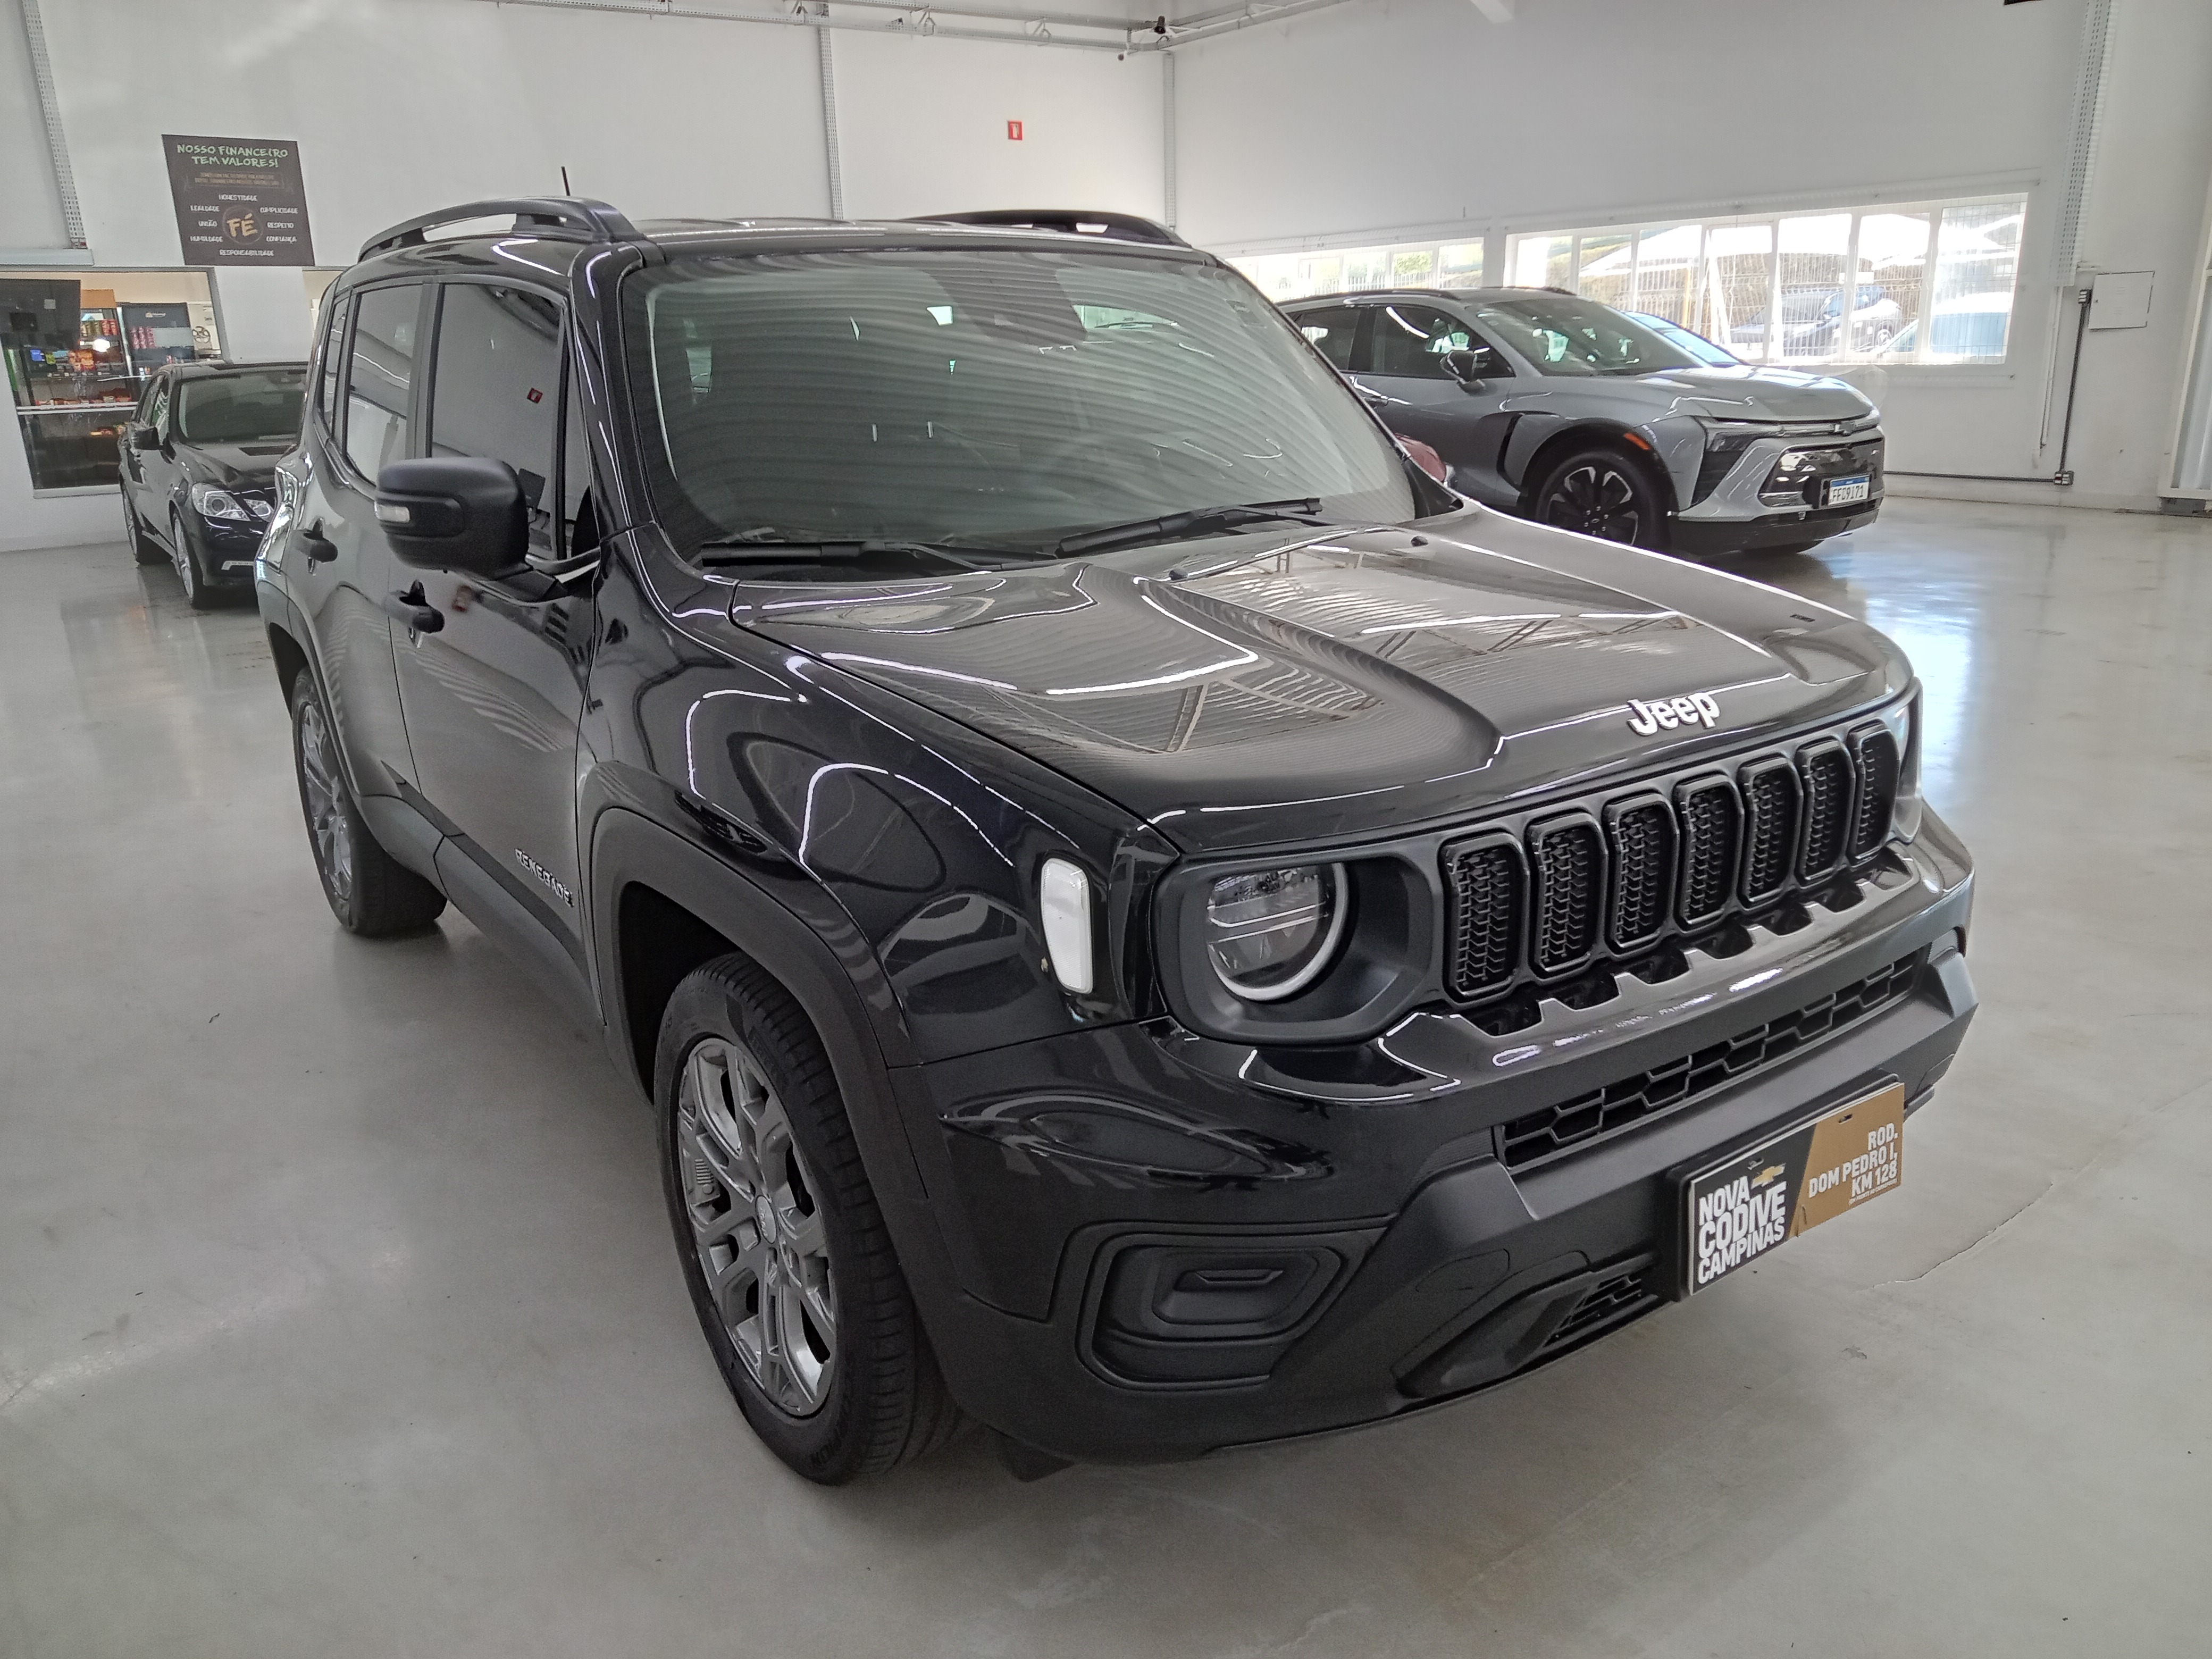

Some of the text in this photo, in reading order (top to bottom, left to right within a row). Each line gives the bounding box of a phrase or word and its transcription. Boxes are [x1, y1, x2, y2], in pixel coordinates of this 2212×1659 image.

[177, 144, 289, 158] NOSSO FINANCEIRO
[191, 156, 279, 167] TEM VALORES!
[227, 213, 258, 237] FÉ
[1626, 692, 1721, 736] Jeep
[515, 848, 574, 907] RENEGADE
[1868, 1123, 1898, 1150] ROD.
[1809, 1167, 1840, 1198] DOM
[1842, 1149, 1887, 1182] PEDRO
[1851, 1175, 1873, 1197] KM
[1875, 1160, 1897, 1186] 128
[1698, 1176, 1750, 1225] NOVA
[1699, 1181, 1787, 1259] CODIVE
[1698, 1217, 1786, 1284] CAMPINAS
